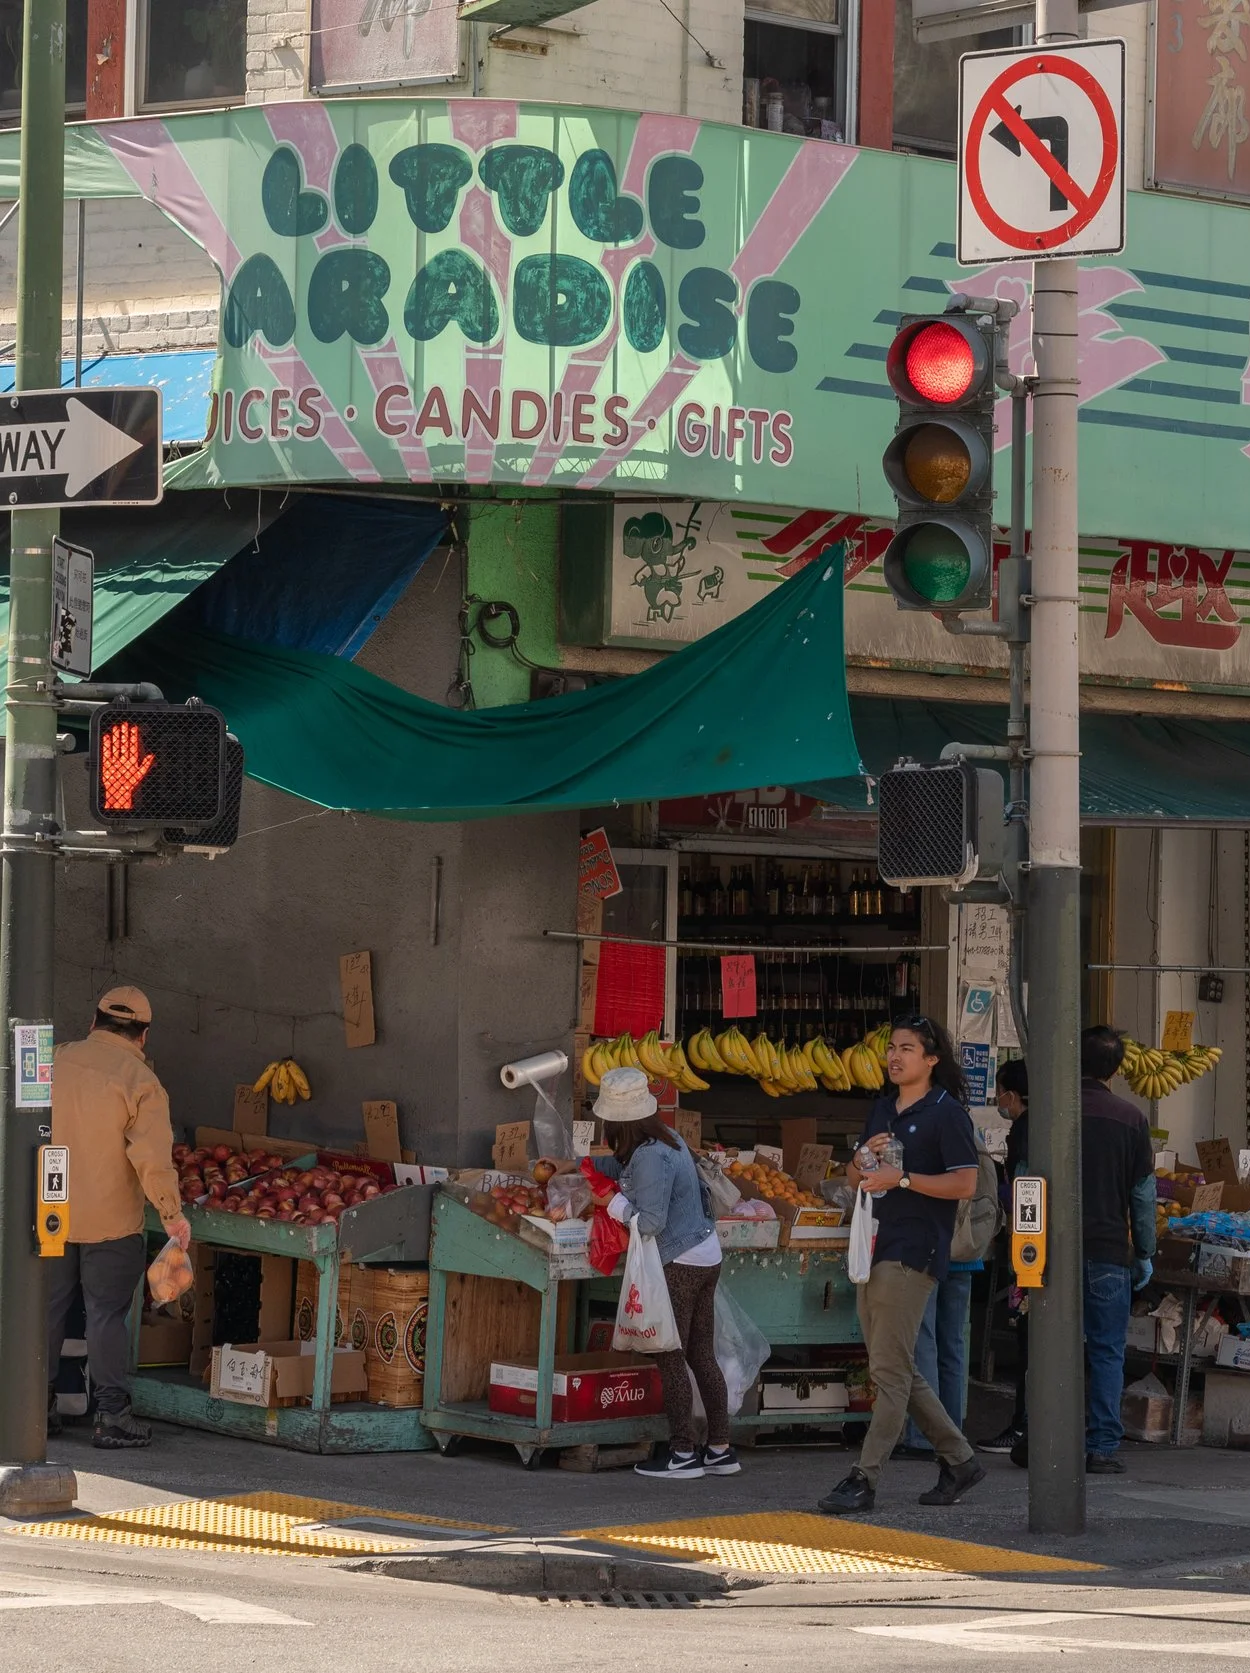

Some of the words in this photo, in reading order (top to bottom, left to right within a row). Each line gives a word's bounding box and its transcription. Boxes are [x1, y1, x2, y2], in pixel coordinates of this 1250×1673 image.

[261, 142, 706, 250] LITTLE
[375, 384, 630, 448] CANDIES
[677, 401, 795, 467] GIFTS
[0, 429, 66, 472] WAY
[749, 808, 787, 829] 1101
[637, 1325, 656, 1339] YOU
[614, 1380, 645, 1403] envy
